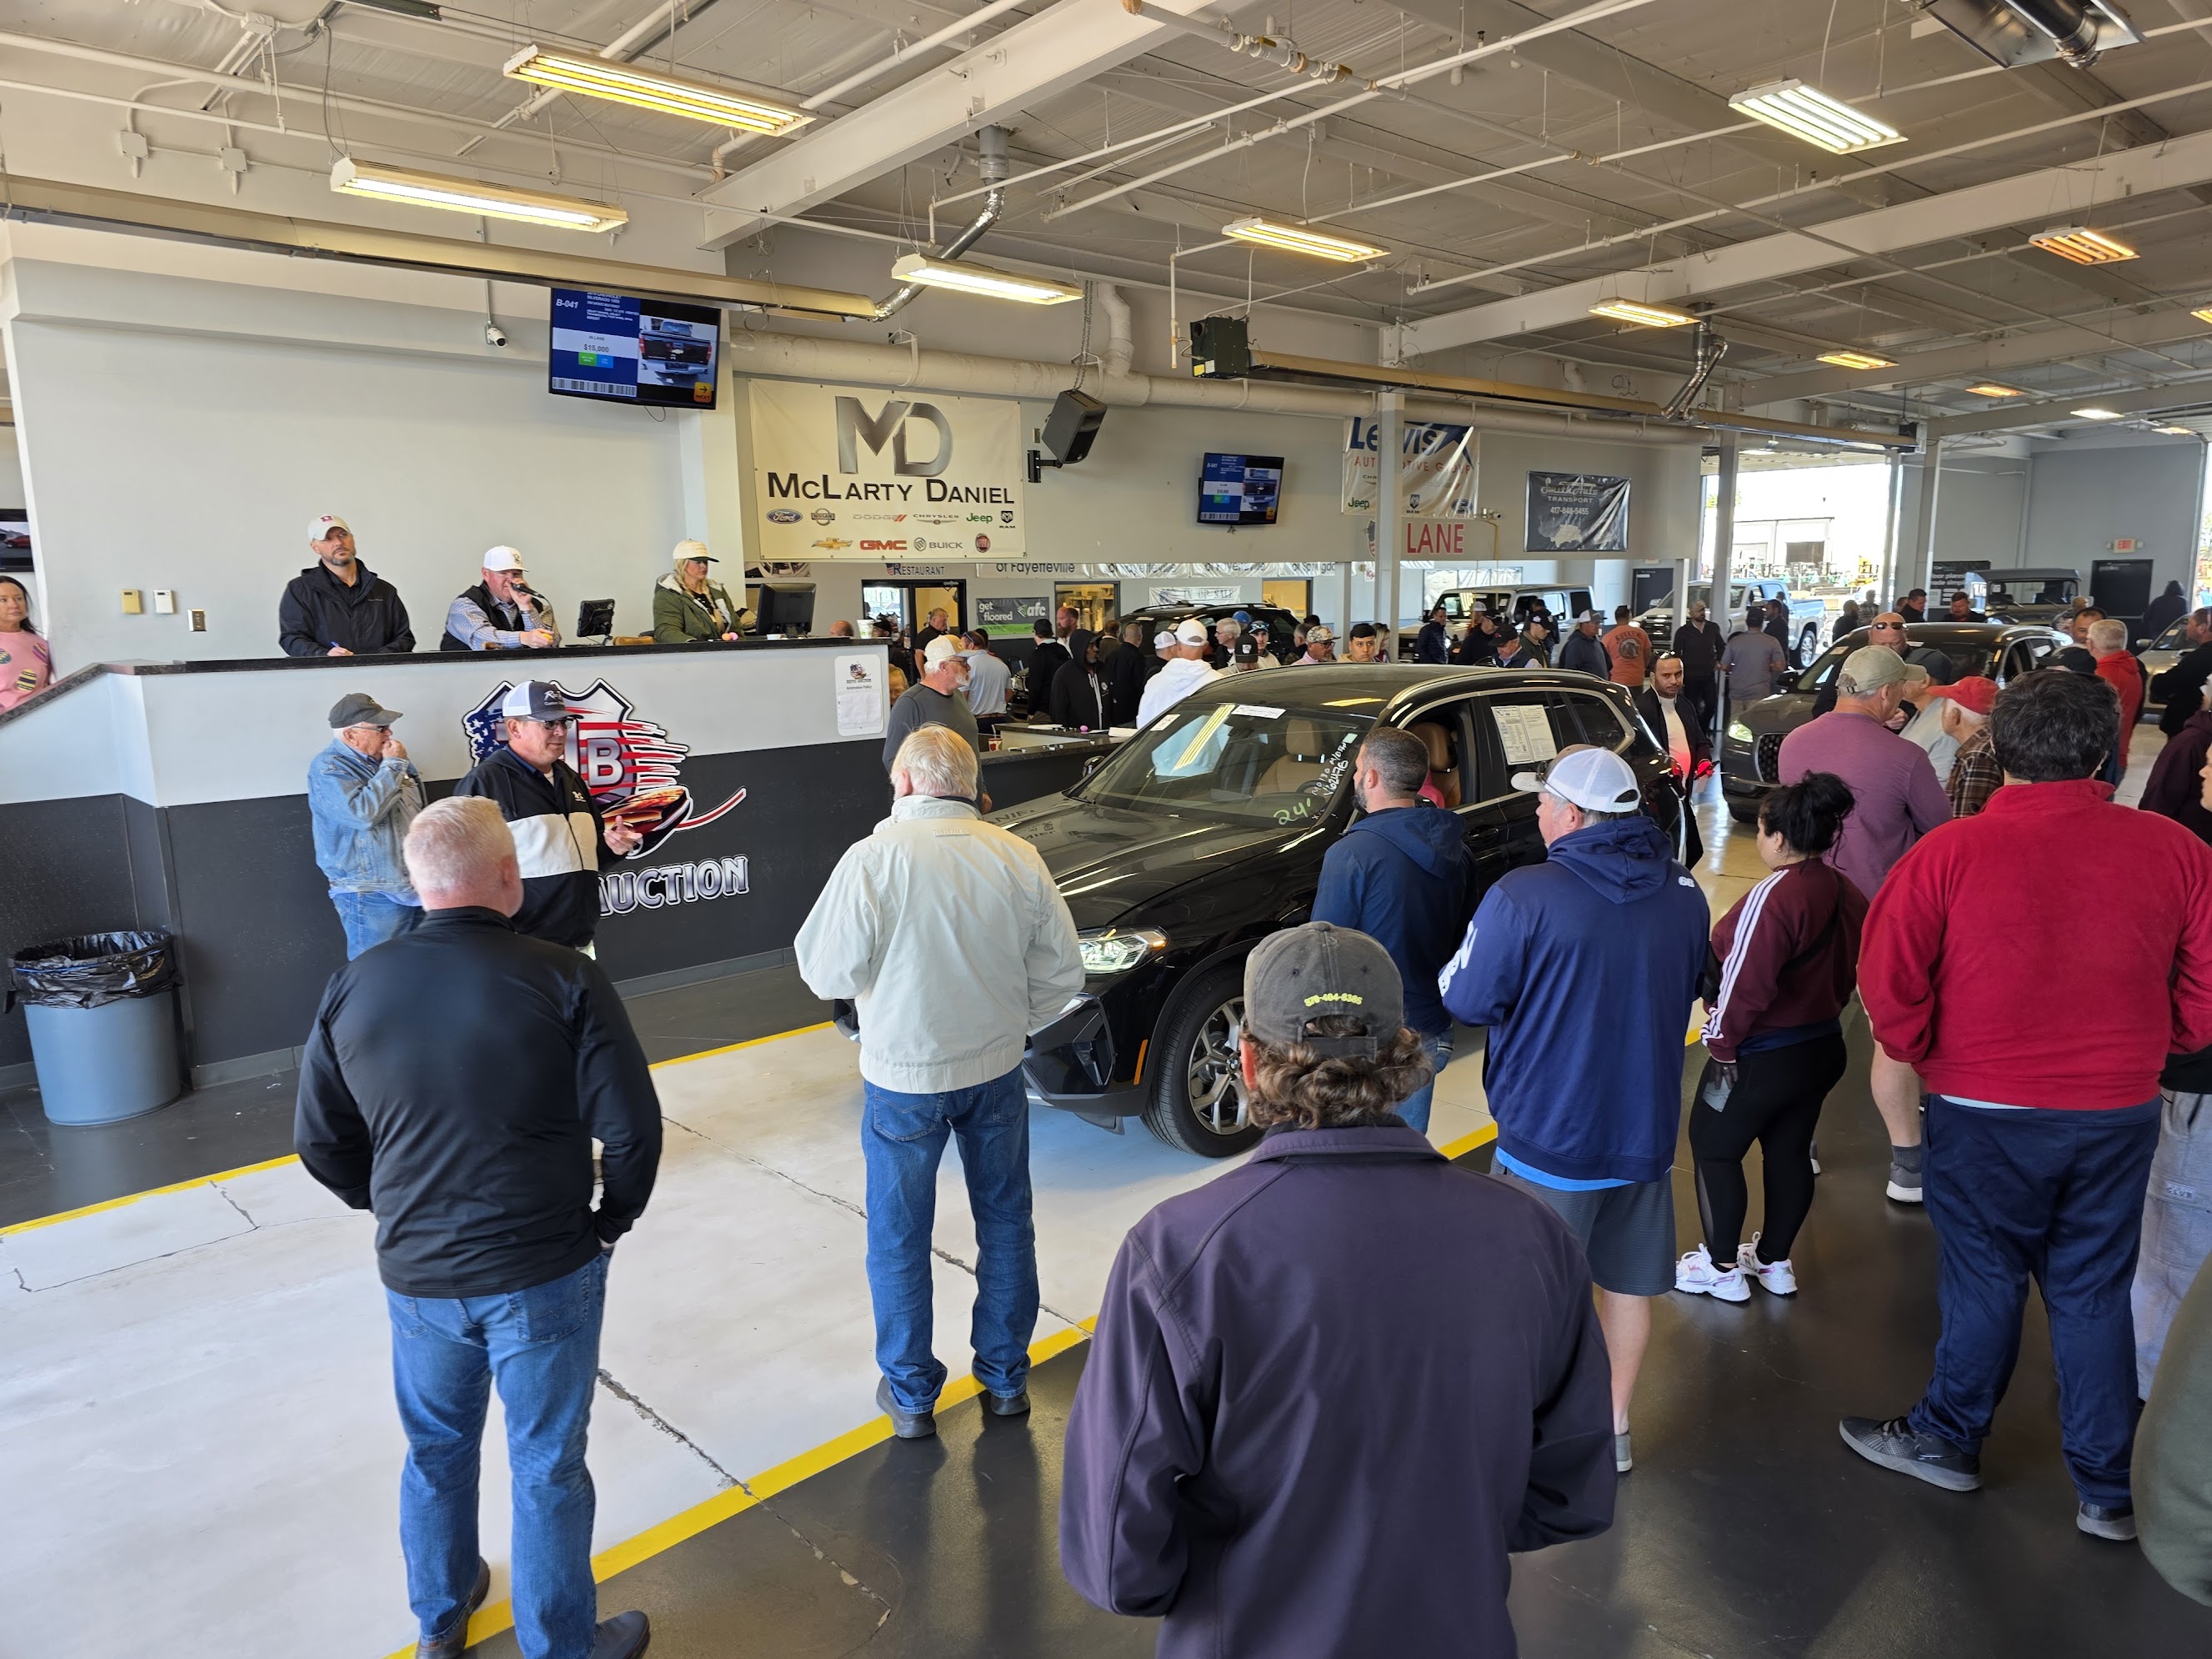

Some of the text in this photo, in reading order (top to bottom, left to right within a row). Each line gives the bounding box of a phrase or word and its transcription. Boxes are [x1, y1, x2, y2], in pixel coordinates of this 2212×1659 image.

[556, 298, 579, 309] B-041
[583, 343, 609, 353] $15,000
[926, 479, 1015, 504] DANIEL
[1348, 497, 1370, 510] Jeep
[1548, 495, 1594, 504] TRANSPORT
[1549, 506, 1589, 515] 417-848-5455
[811, 513, 835, 521] NISSAN
[853, 514, 898, 522] DODGE
[966, 513, 993, 524] Jeep
[1406, 522, 1464, 554] LANE
[859, 539, 908, 551] GMC
[893, 563, 945, 575] RESTAURANT
[978, 601, 994, 613] get
[1026, 602, 1046, 617] afc
[983, 610, 1013, 622] floored
